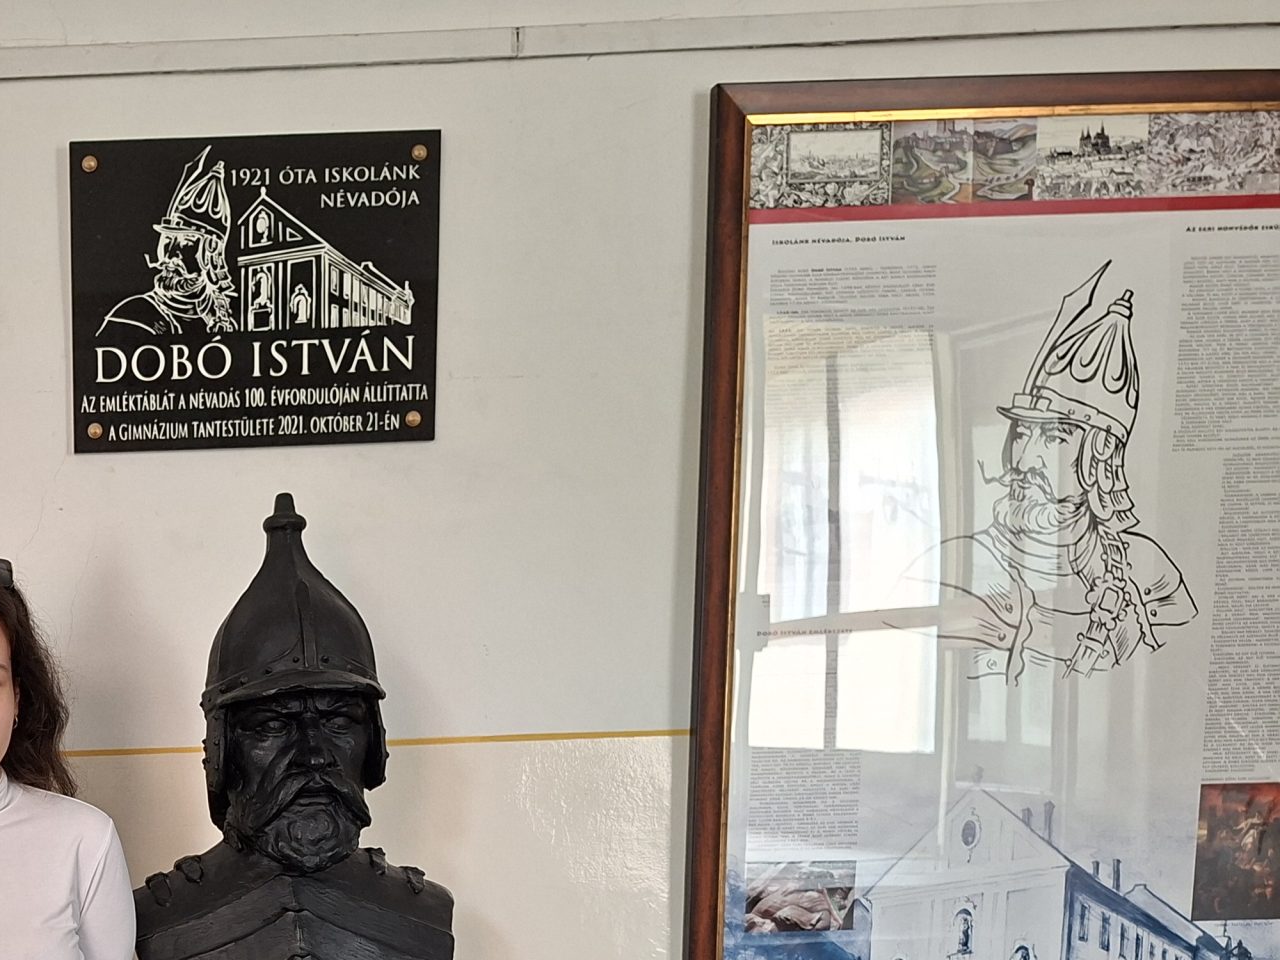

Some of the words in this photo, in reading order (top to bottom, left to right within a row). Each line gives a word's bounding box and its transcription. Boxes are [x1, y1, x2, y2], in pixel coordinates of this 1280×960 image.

[230, 167, 270, 187] 1921
[278, 165, 317, 185] ÓTA
[324, 162, 421, 184] ISKOLÁNK
[320, 186, 420, 209] NÉVADÓJA
[94, 335, 232, 383] DOBÓ
[251, 329, 416, 378] ISTVÁN
[81, 398, 97, 414] AZ
[99, 390, 176, 413] EMLÉKTÁBLÁT
[178, 393, 186, 409] A
[189, 388, 241, 410] NÉVADÁS
[244, 387, 268, 408] 100.
[271, 384, 360, 408] ÉVFORDULÓJÁN
[363, 383, 428, 403] ÁLLÍTTATTA
[108, 424, 117, 441] A
[119, 420, 189, 441] GIMNÁZIUM
[192, 415, 275, 439] TANTESTÜLETE
[278, 415, 308, 436] 2021.
[310, 411, 364, 434] OKTÓBER
[366, 411, 400, 432] 21-ÉN
